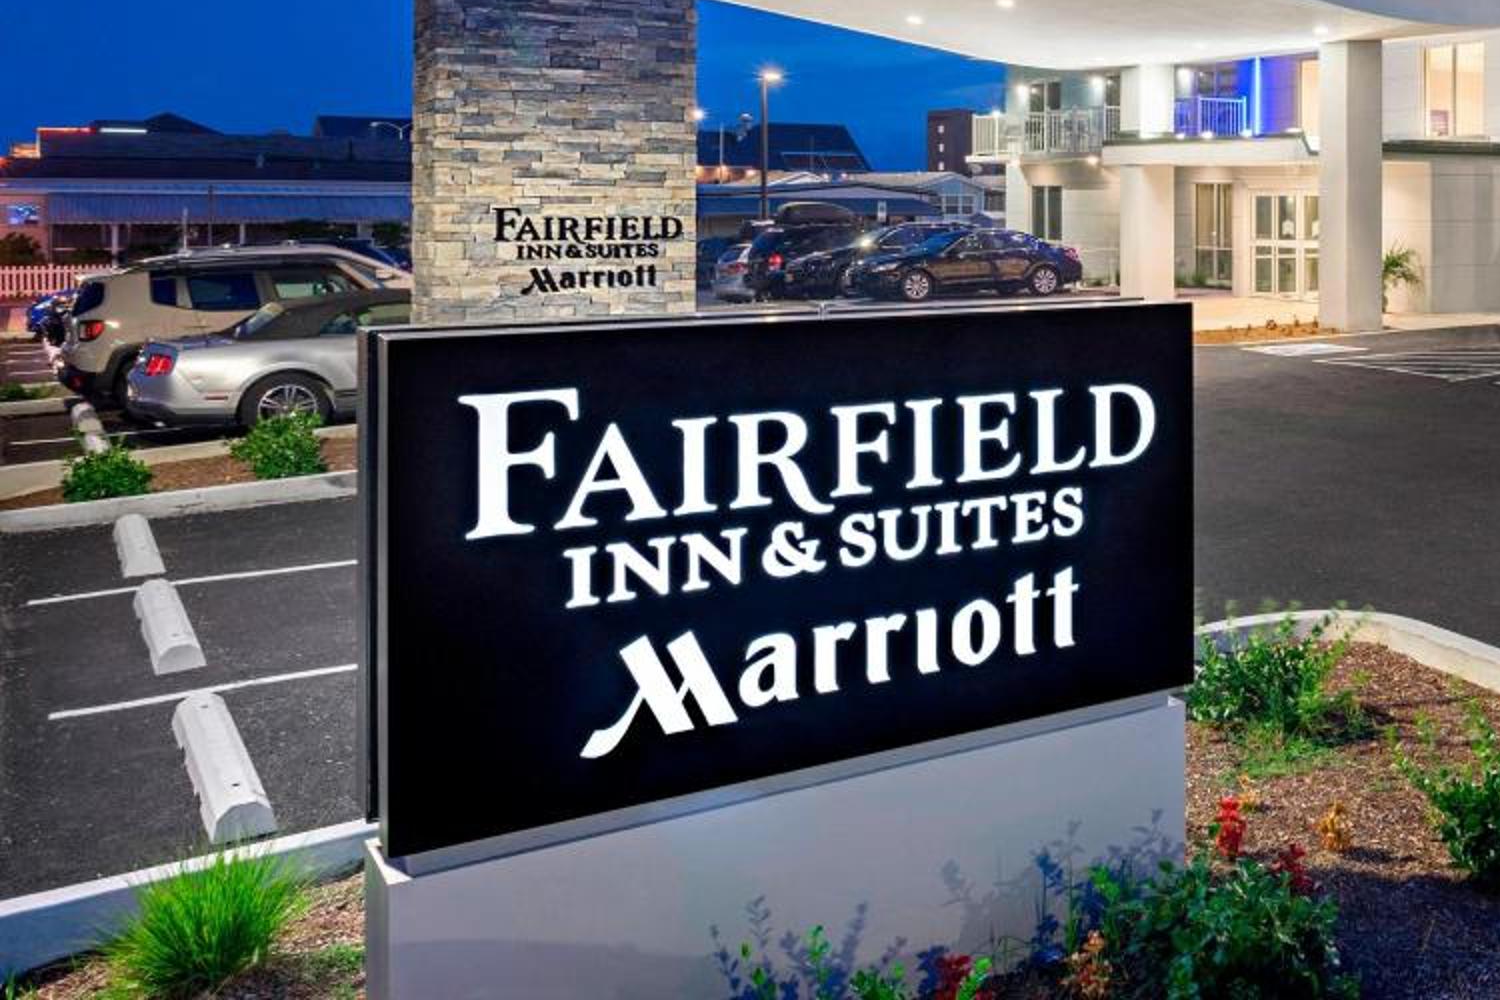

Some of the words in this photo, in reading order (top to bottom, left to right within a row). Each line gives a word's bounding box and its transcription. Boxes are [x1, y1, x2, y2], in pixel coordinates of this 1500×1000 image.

[492, 207, 684, 245] FAIRFIELD
[517, 245, 562, 260] INN
[565, 244, 583, 259] &
[585, 243, 659, 259] SUITES
[520, 264, 657, 296] Marriott
[457, 382, 1157, 541] FAIRFIELD
[562, 532, 743, 609] INN
[761, 520, 827, 578] &
[838, 485, 1085, 569] SUITES
[579, 565, 1081, 760] Marriott
